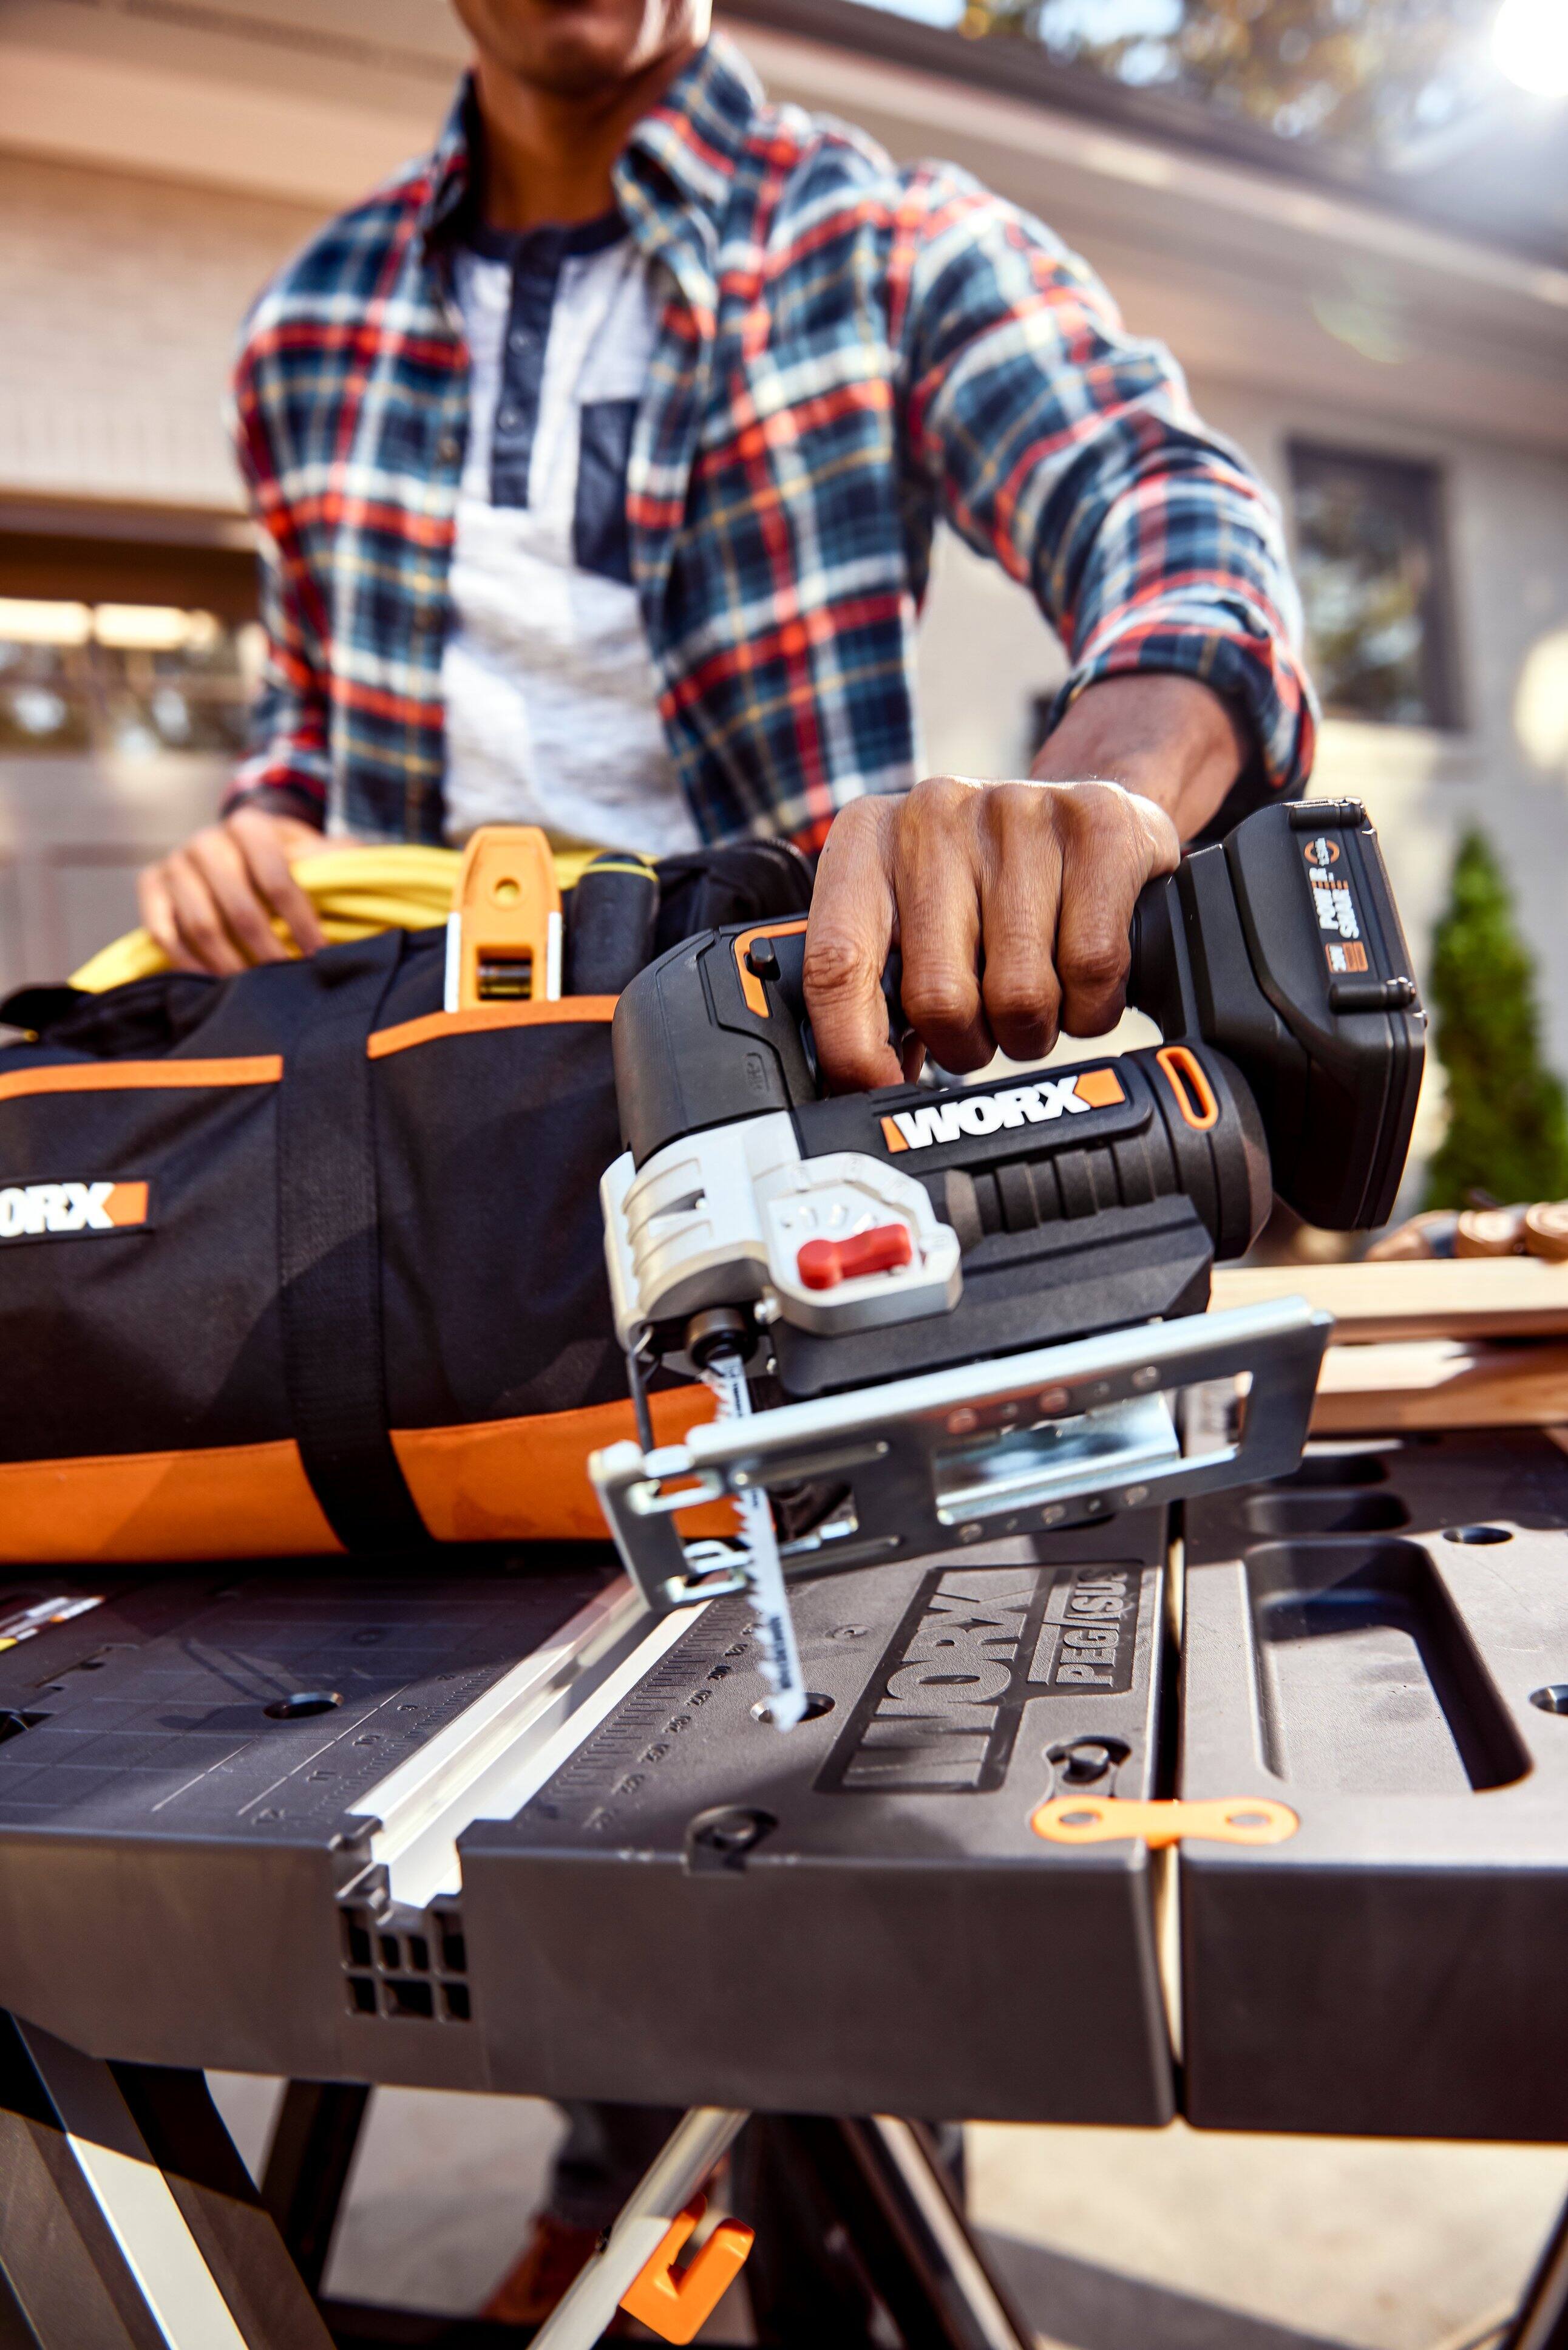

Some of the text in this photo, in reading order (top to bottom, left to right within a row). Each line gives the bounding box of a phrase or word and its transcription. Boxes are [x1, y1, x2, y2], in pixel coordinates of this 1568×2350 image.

[892, 1076, 1091, 1149] WORX
[854, 1586, 1034, 1773] WORX
[1056, 1568, 1128, 1686] PEGASUS
